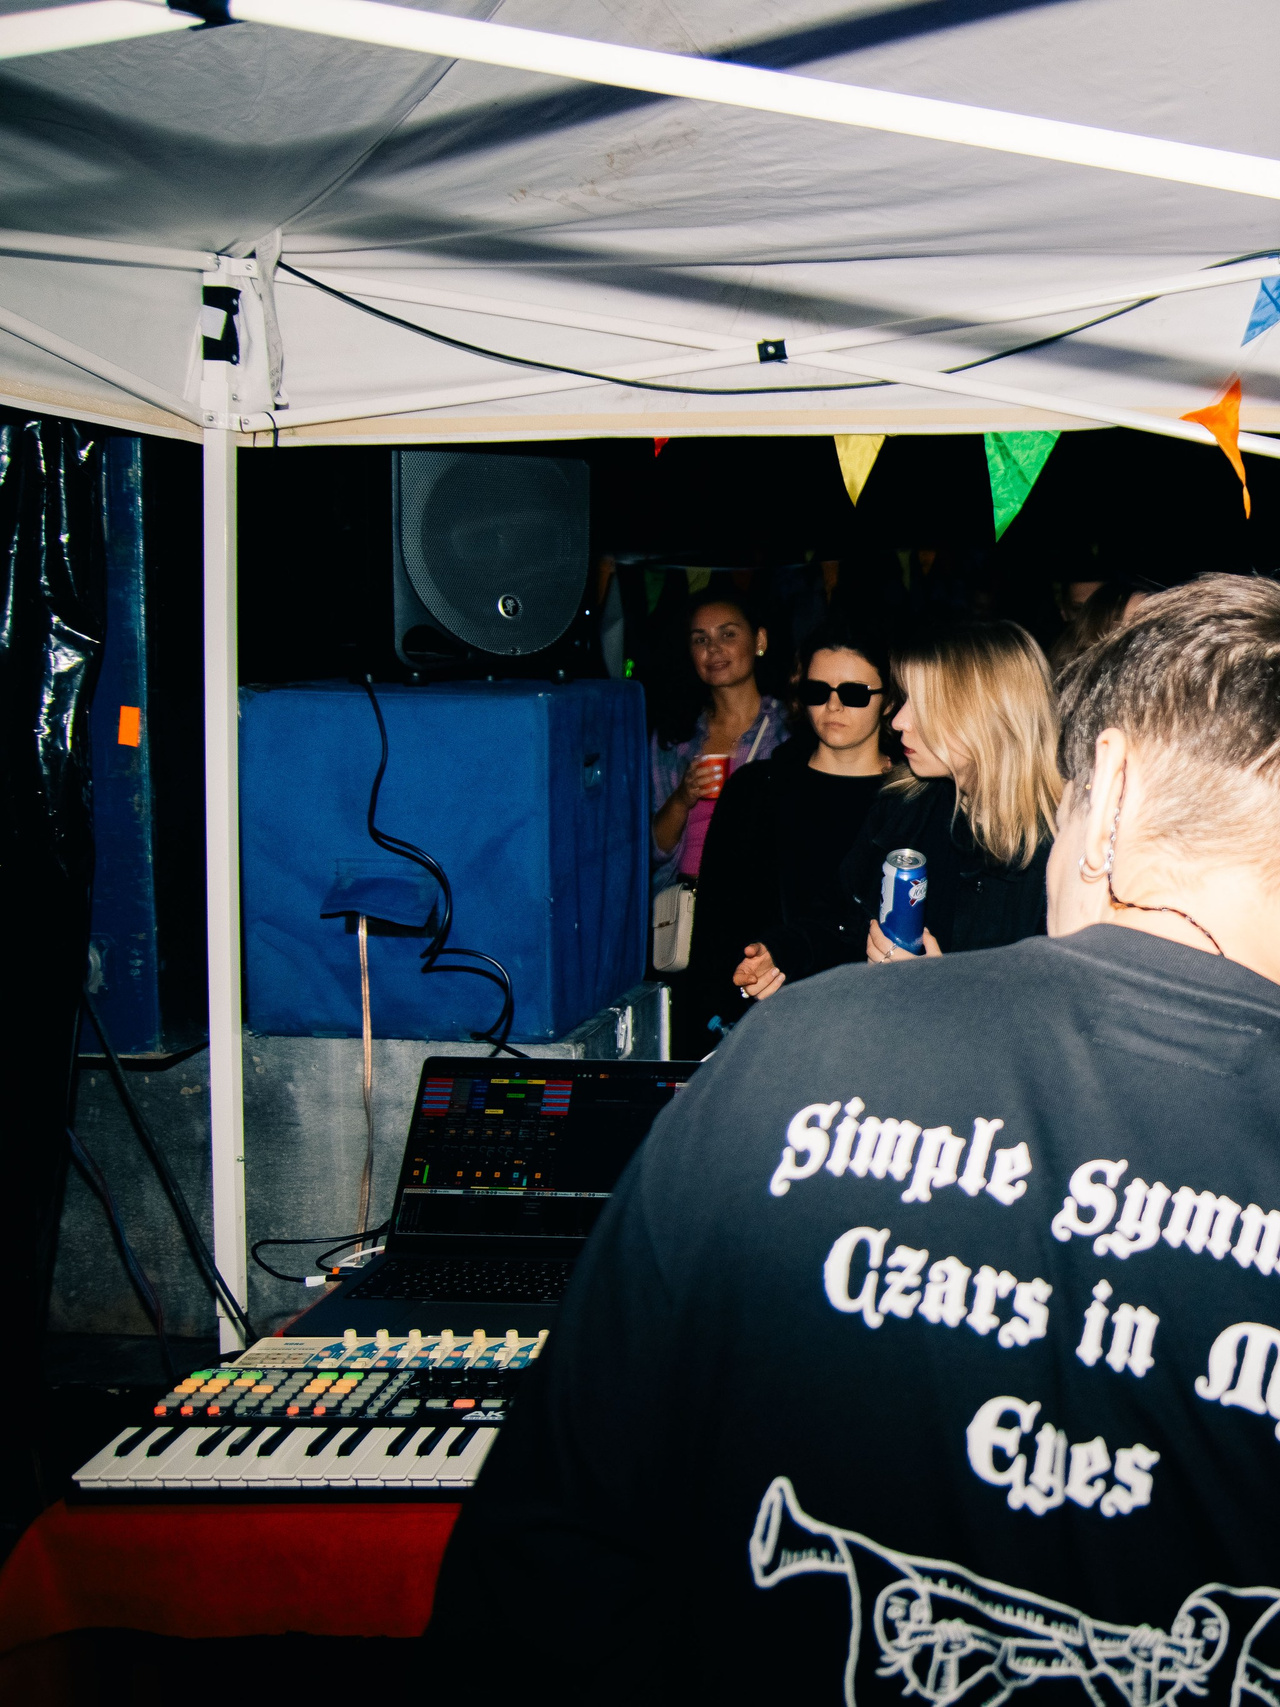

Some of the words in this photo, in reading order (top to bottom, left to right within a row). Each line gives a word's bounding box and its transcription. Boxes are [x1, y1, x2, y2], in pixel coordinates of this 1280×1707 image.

[769, 1096, 1032, 1206] Simple
[824, 1227, 1052, 1348] Czars
[1076, 1279, 1159, 1377] in
[966, 1396, 1160, 1517] Eyes
